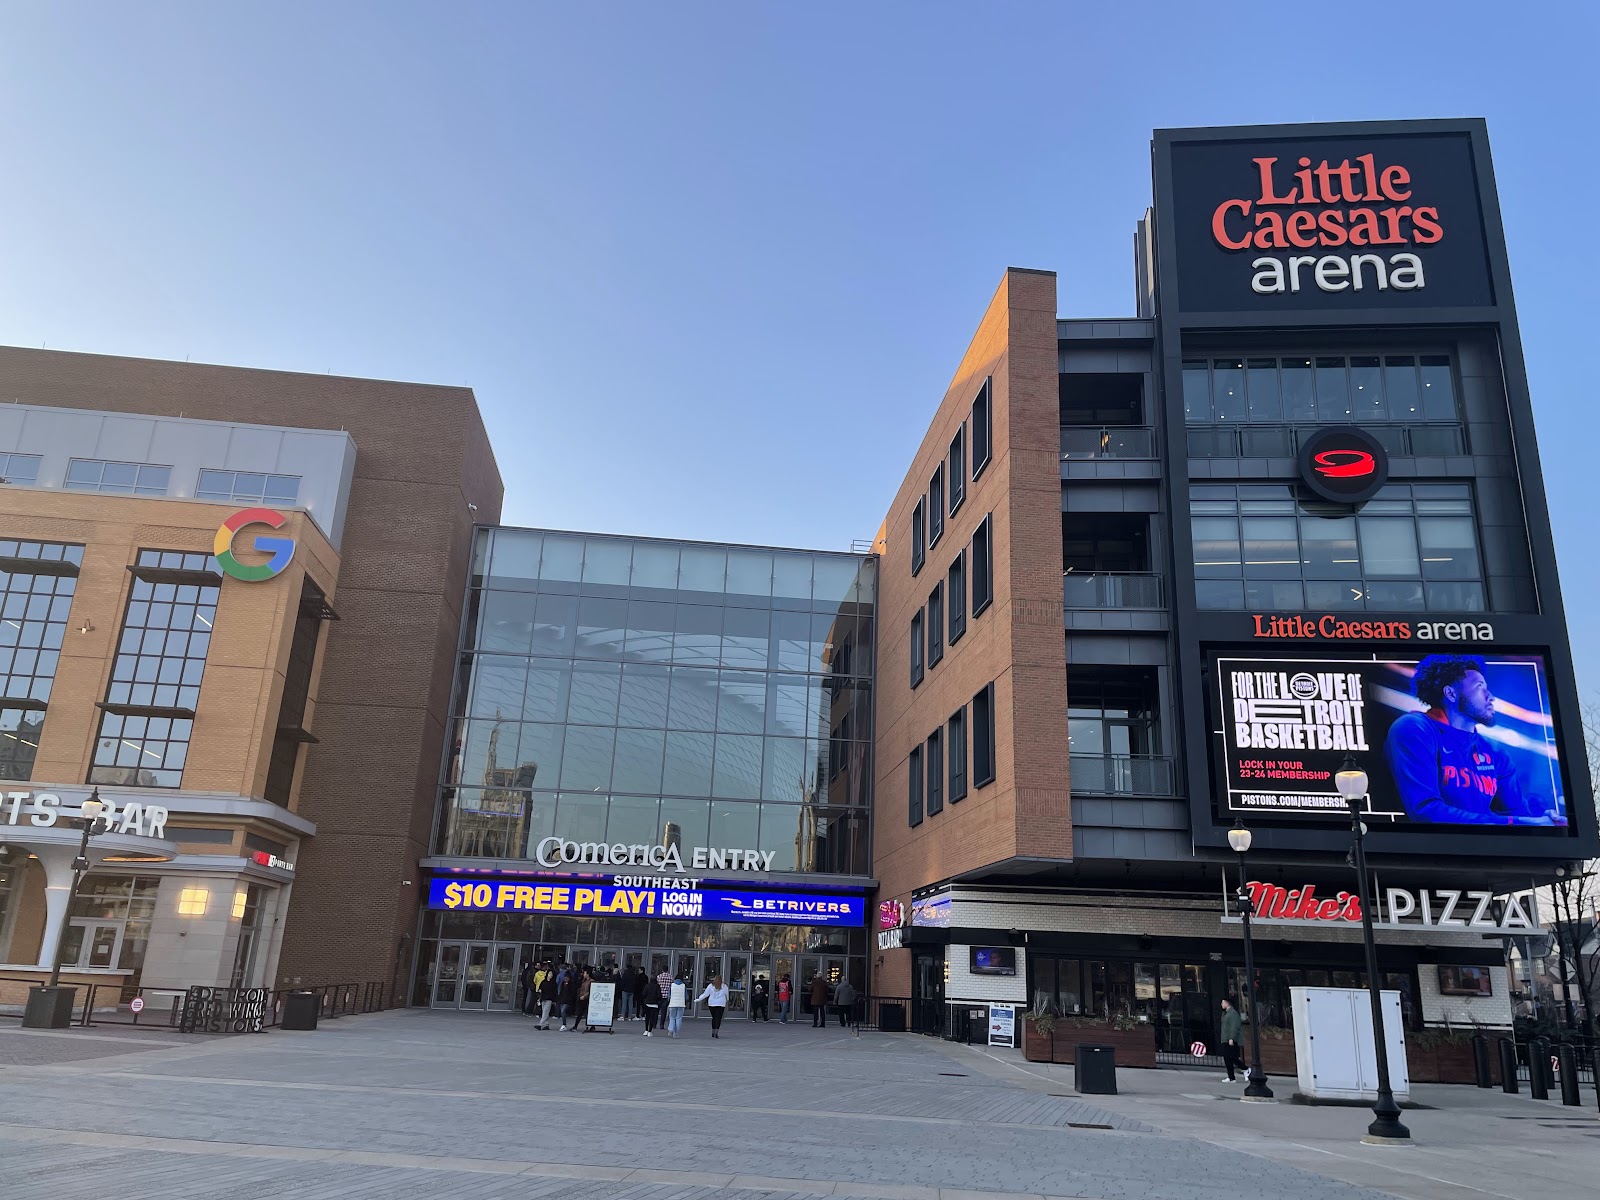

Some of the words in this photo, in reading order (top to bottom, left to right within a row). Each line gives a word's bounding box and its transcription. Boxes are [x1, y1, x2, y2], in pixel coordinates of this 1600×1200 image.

[1252, 153, 1412, 205] Little
[1212, 199, 1444, 249] Caesars
[1251, 252, 1426, 294] arena
[1252, 615, 1317, 639] Little
[1318, 616, 1411, 640] Caesars
[1416, 622, 1494, 641] arena
[1231, 671, 1255, 699] FOR
[1254, 672, 1279, 699] THE
[1347, 673, 1362, 701] OF
[1233, 699, 1365, 725] DETROIT
[1235, 722, 1370, 751] BASKETBALL
[1239, 760, 1264, 769] LOCK
[1265, 761, 1276, 769] IN
[1277, 761, 1304, 770] YOUR
[1240, 769, 1266, 778] 23-24
[1267, 770, 1331, 780] MEMBERSHIP
[90, 798, 169, 839] BAR
[692, 847, 776, 872] ENTRY
[613, 875, 699, 890] SOUTHEAST
[443, 882, 493, 908] $10
[496, 885, 571, 911] FREE
[574, 889, 656, 914] PLAY!
[661, 902, 702, 917] NOW!
[662, 892, 685, 903] LOG
[686, 893, 703, 904] IN
[753, 899, 851, 914] BETRIVERS
[1236, 881, 1363, 922] Mike's
[1386, 888, 1534, 929] PIZZA
